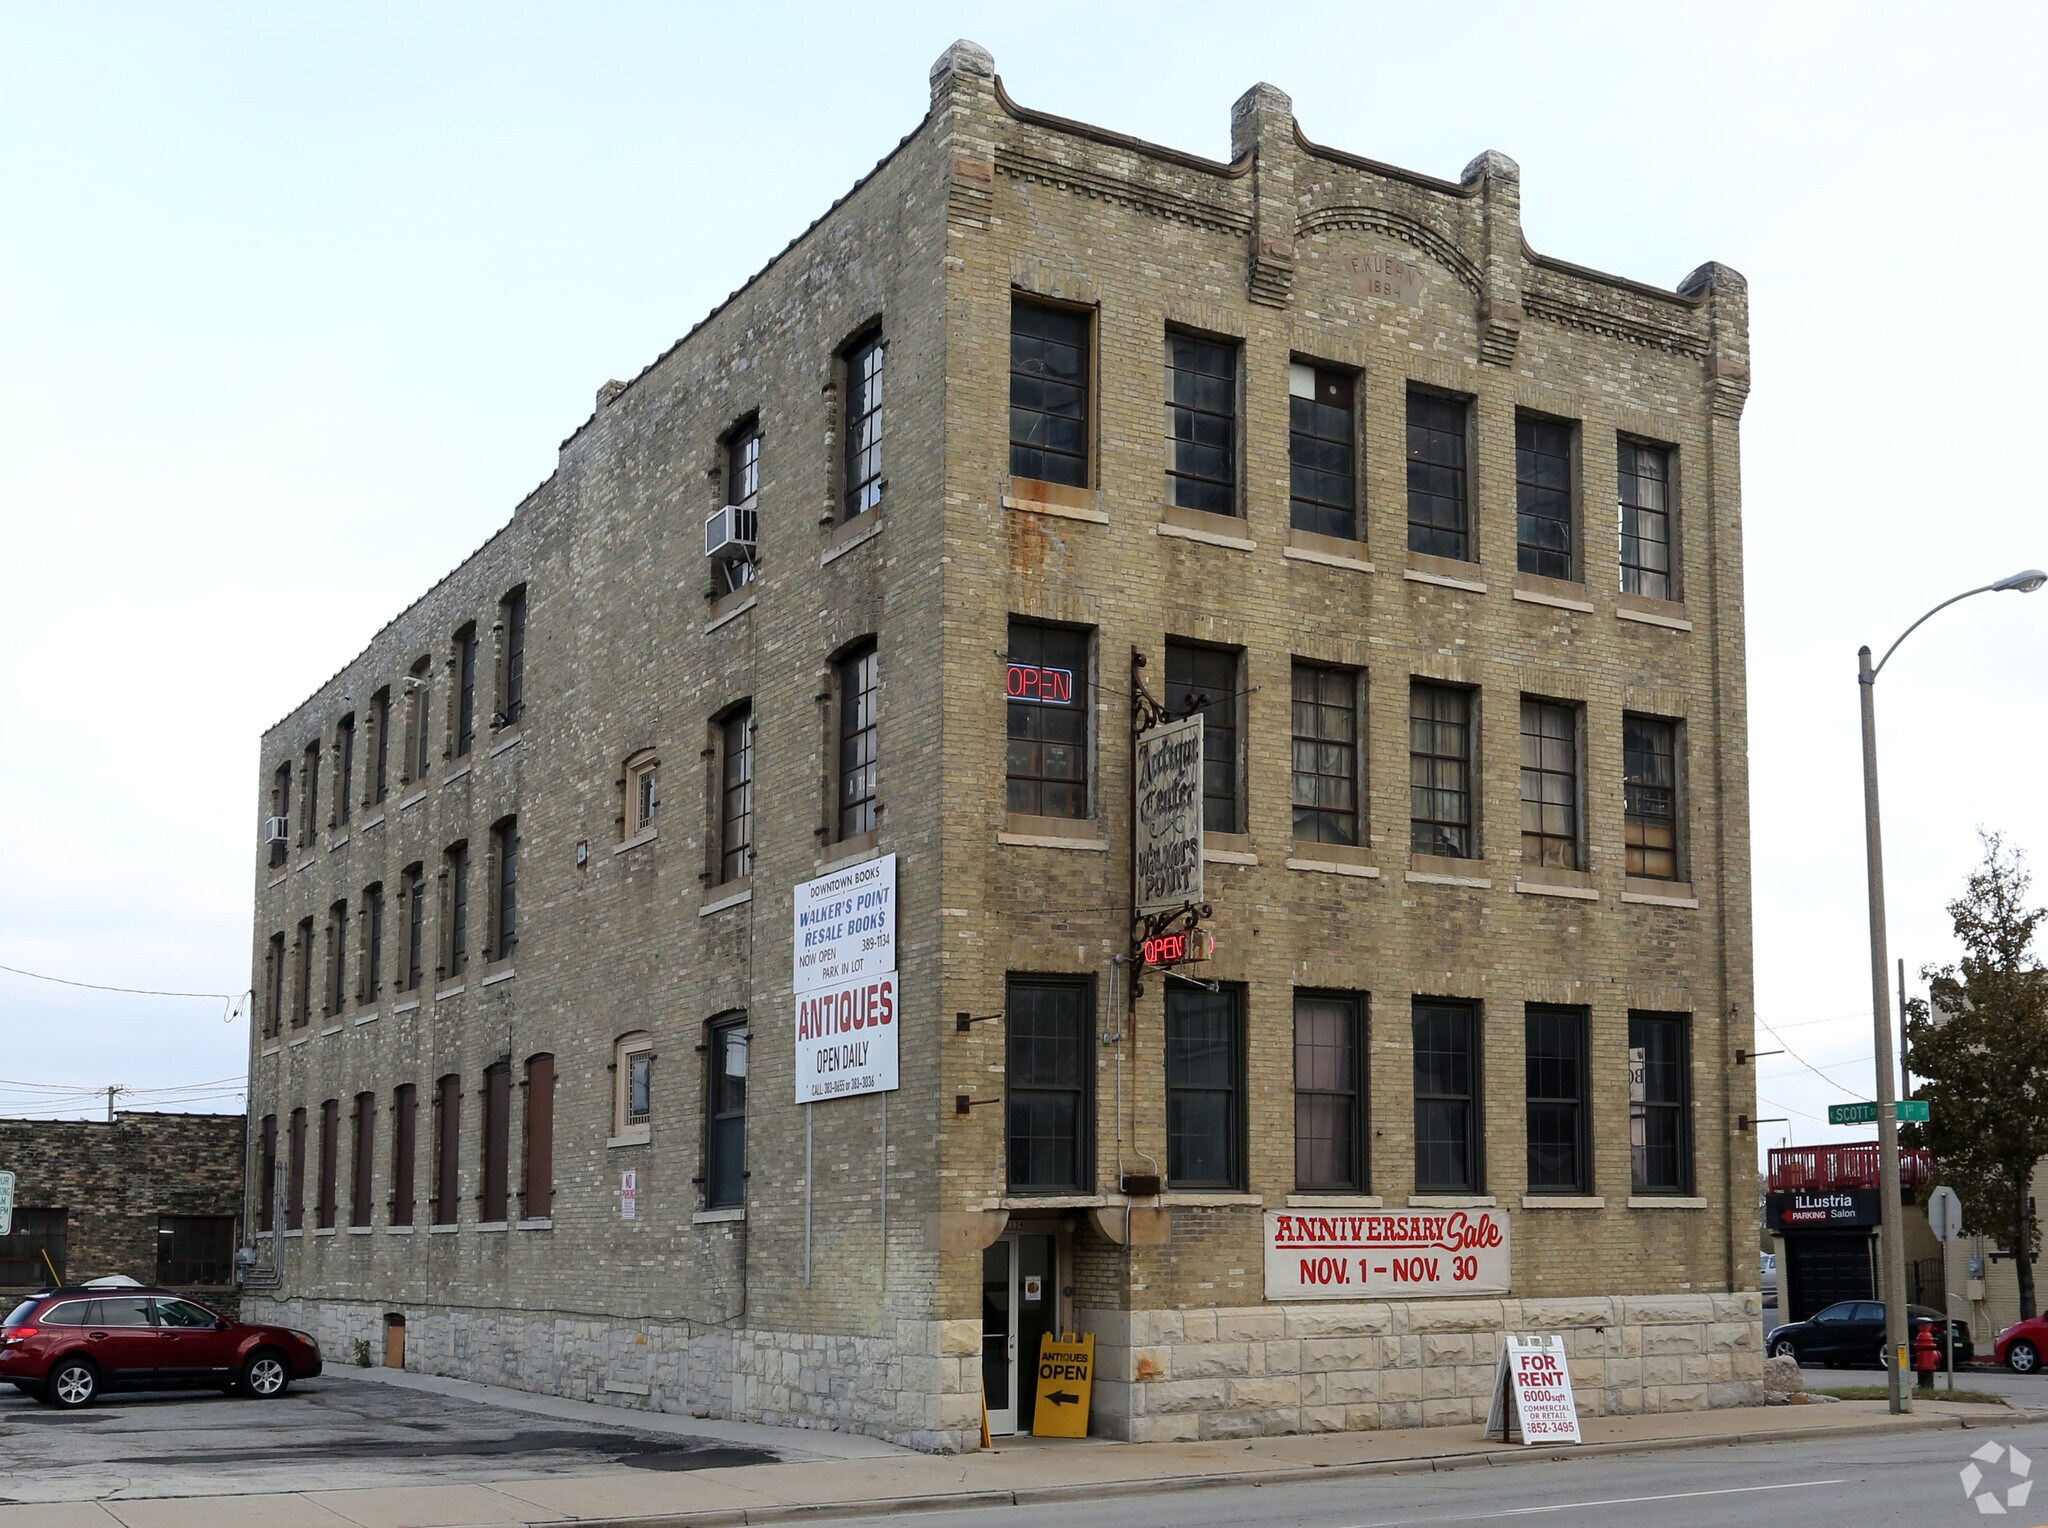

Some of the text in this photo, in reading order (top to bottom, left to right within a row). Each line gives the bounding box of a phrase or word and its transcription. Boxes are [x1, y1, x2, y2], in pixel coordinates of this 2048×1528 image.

[1007, 667, 1070, 701] OPEN
[811, 866, 880, 898] DOWNTOWN BOOKS
[800, 887, 890, 927] WALKER'S POINT
[804, 911, 885, 947] RESALE BOOKS
[799, 933, 889, 968] NOW OPEN 389-1134
[1145, 935, 1185, 963] OPEN
[822, 958, 864, 980] PARK IN LOT
[799, 981, 893, 1042] ANTIQUES
[816, 1041, 869, 1074] OPEN DAILY
[1836, 1106, 1869, 1120] SCOTT
[1792, 1211, 1826, 1220] PARKING
[1830, 1209, 1856, 1218] Salon
[1275, 1211, 1503, 1252] ANNIVERSARY Sale
[1300, 1257, 1350, 1284] NOV.
[1358, 1258, 1367, 1283] 1
[1393, 1257, 1440, 1282] NOV.
[1453, 1255, 1478, 1281] 30
[1041, 1352, 1088, 1364] ANTIQUES
[1520, 1355, 1557, 1370] FOR
[1039, 1364, 1087, 1381] OPEN
[1517, 1372, 1564, 1387] RENT
[1523, 1404, 1571, 1412] COMMERCIAL
[1531, 1422, 1574, 1433] 852-3495
